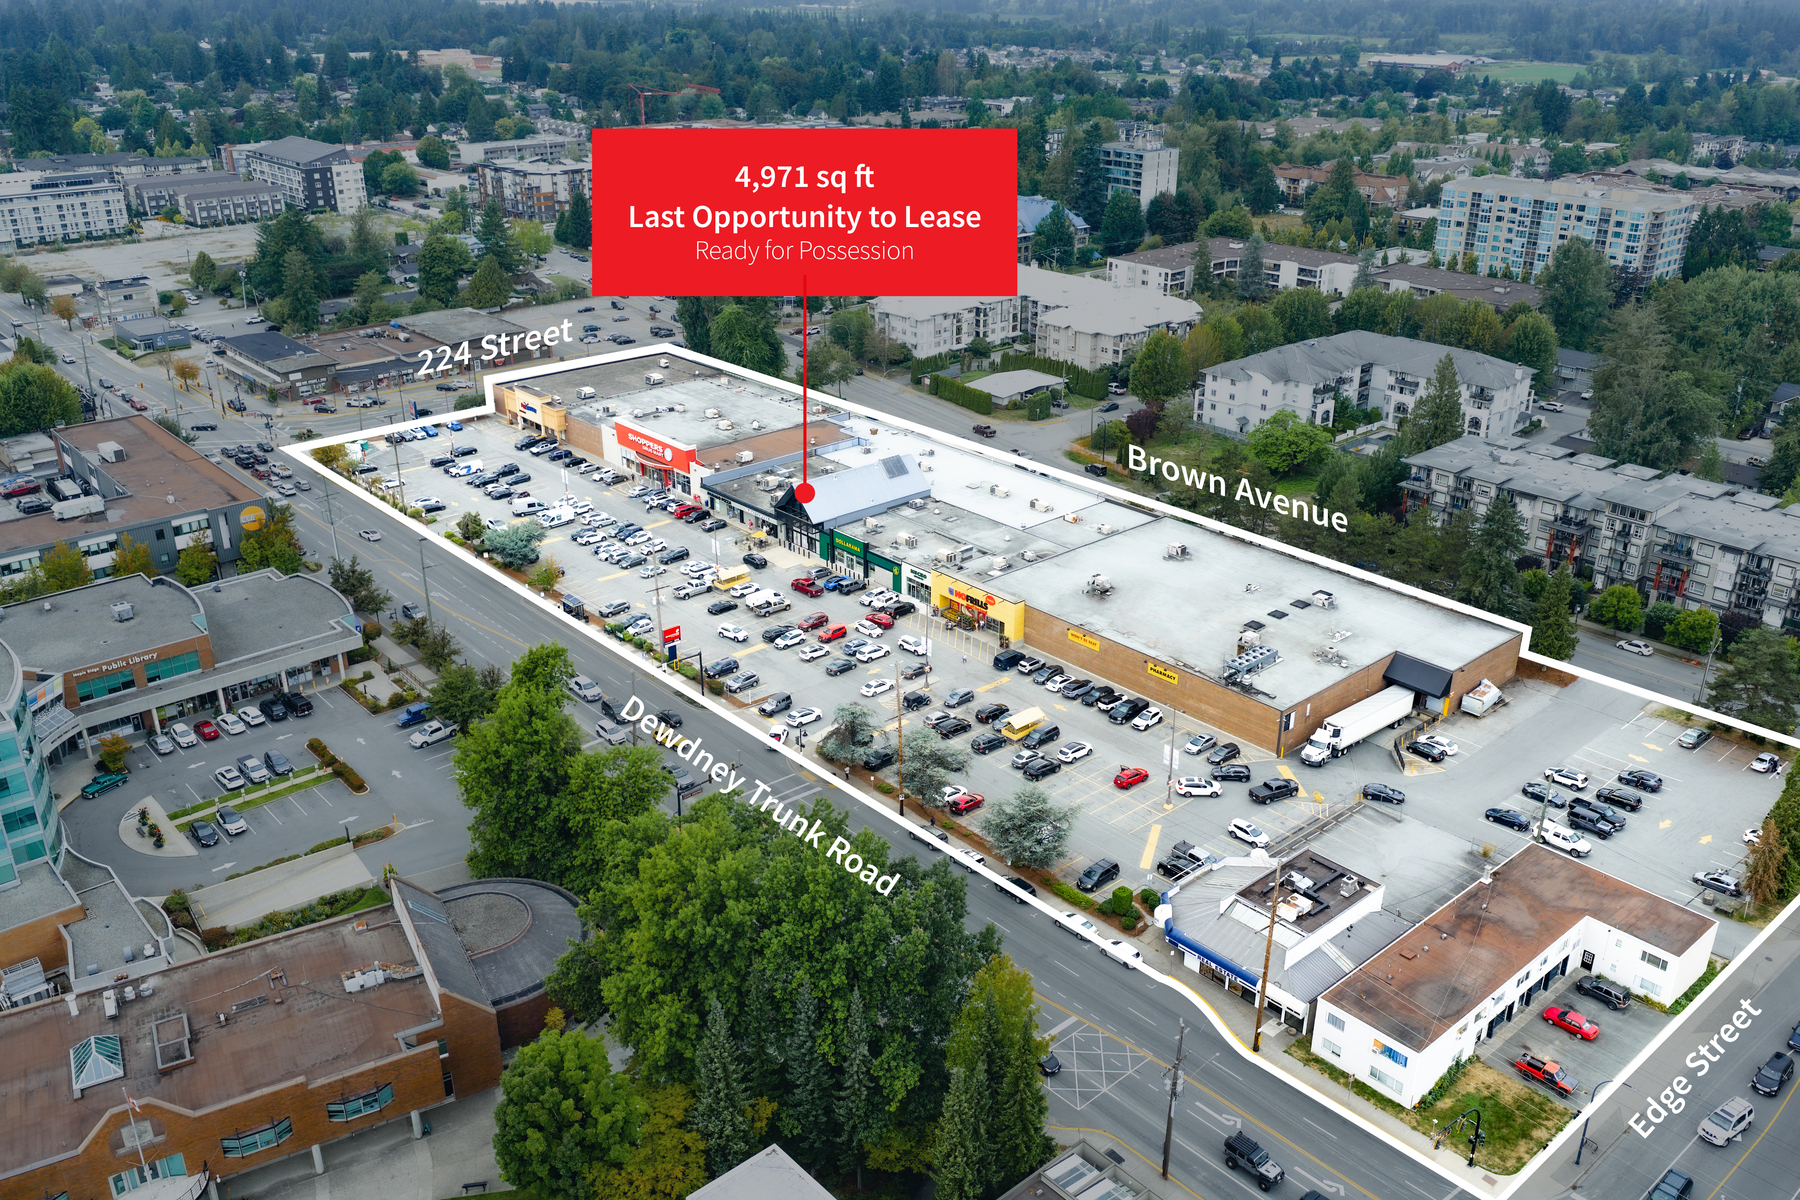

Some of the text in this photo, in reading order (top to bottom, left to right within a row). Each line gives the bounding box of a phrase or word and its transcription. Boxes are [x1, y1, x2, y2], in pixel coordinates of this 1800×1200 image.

[628, 433, 663, 452] SHOPPERS
[836, 538, 860, 552] DOLLARAMA
[72, 670, 87, 678] Maple
[102, 660, 127, 672] Public
[128, 652, 158, 665] Library
[1150, 666, 1176, 681] PHARMACY
[1197, 954, 1238, 983] REAL ESTATE
